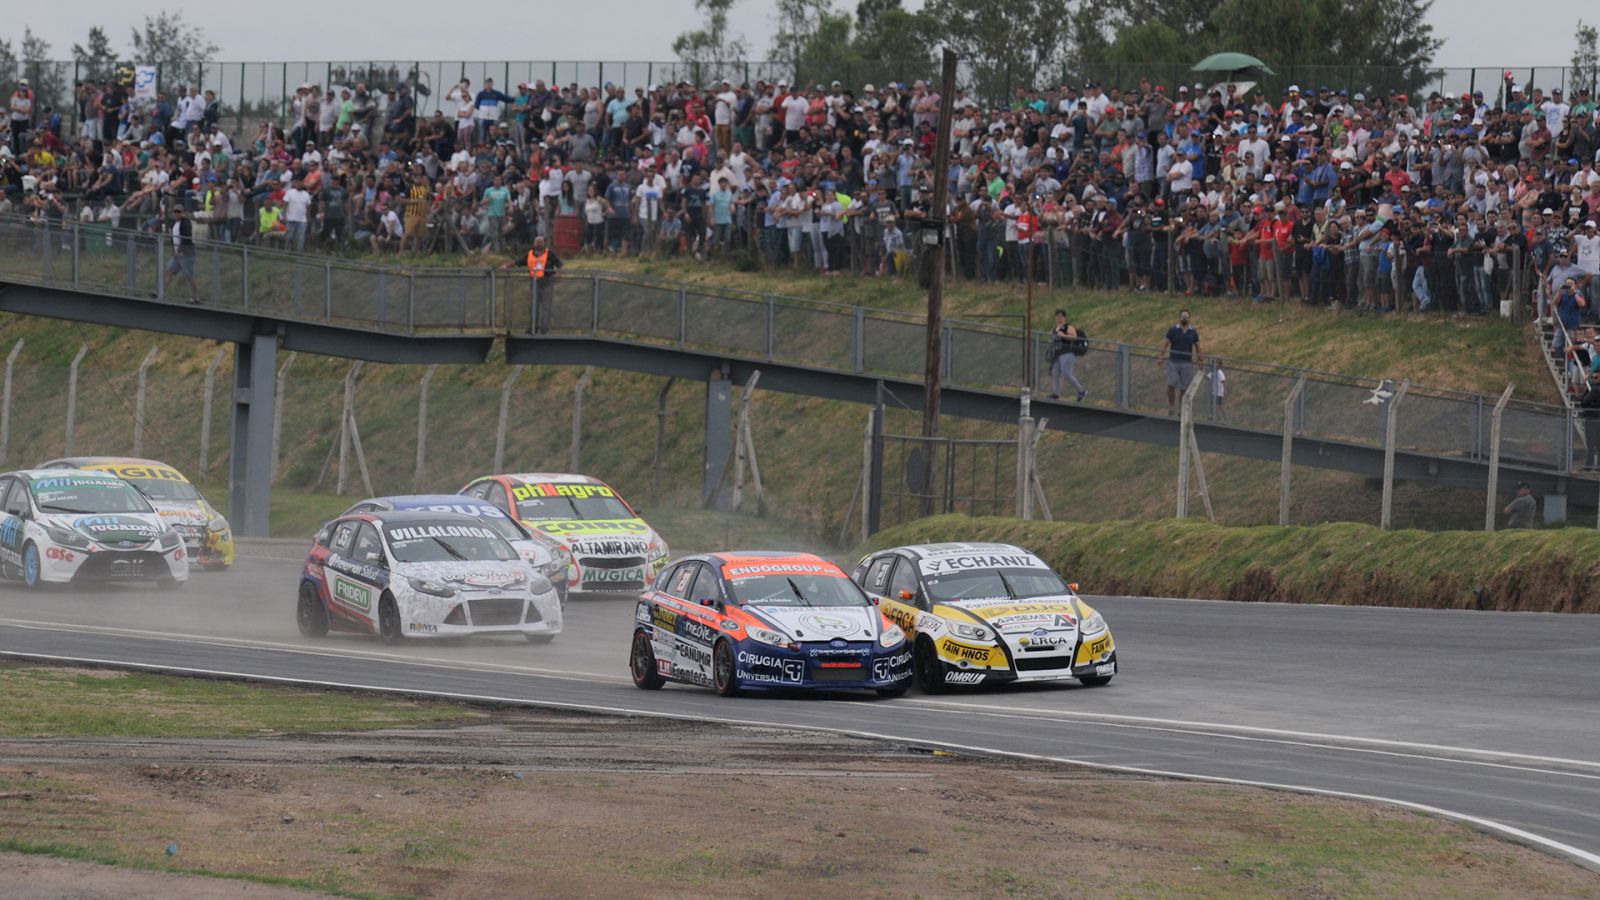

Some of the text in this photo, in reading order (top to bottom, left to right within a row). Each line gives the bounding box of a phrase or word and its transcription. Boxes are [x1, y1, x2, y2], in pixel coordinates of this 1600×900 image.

[390, 525, 497, 540] VILLALONGA
[537, 521, 646, 534] COIRO
[571, 541, 648, 556] ALTAMIRANO
[729, 563, 822, 576] ENDOGROUP
[949, 555, 1036, 570] ECHANIZ
[582, 568, 644, 582] MUGICA
[337, 581, 368, 605] FRIDEVI
[891, 607, 915, 634] ERCA
[997, 613, 1053, 625] ARSEMET
[409, 622, 438, 632] ROMA
[1031, 636, 1067, 646] ERCA
[942, 641, 990, 661] FAIN HNOS
[738, 650, 783, 669] CIRUGIA
[736, 669, 781, 684] UNIVERSAL
